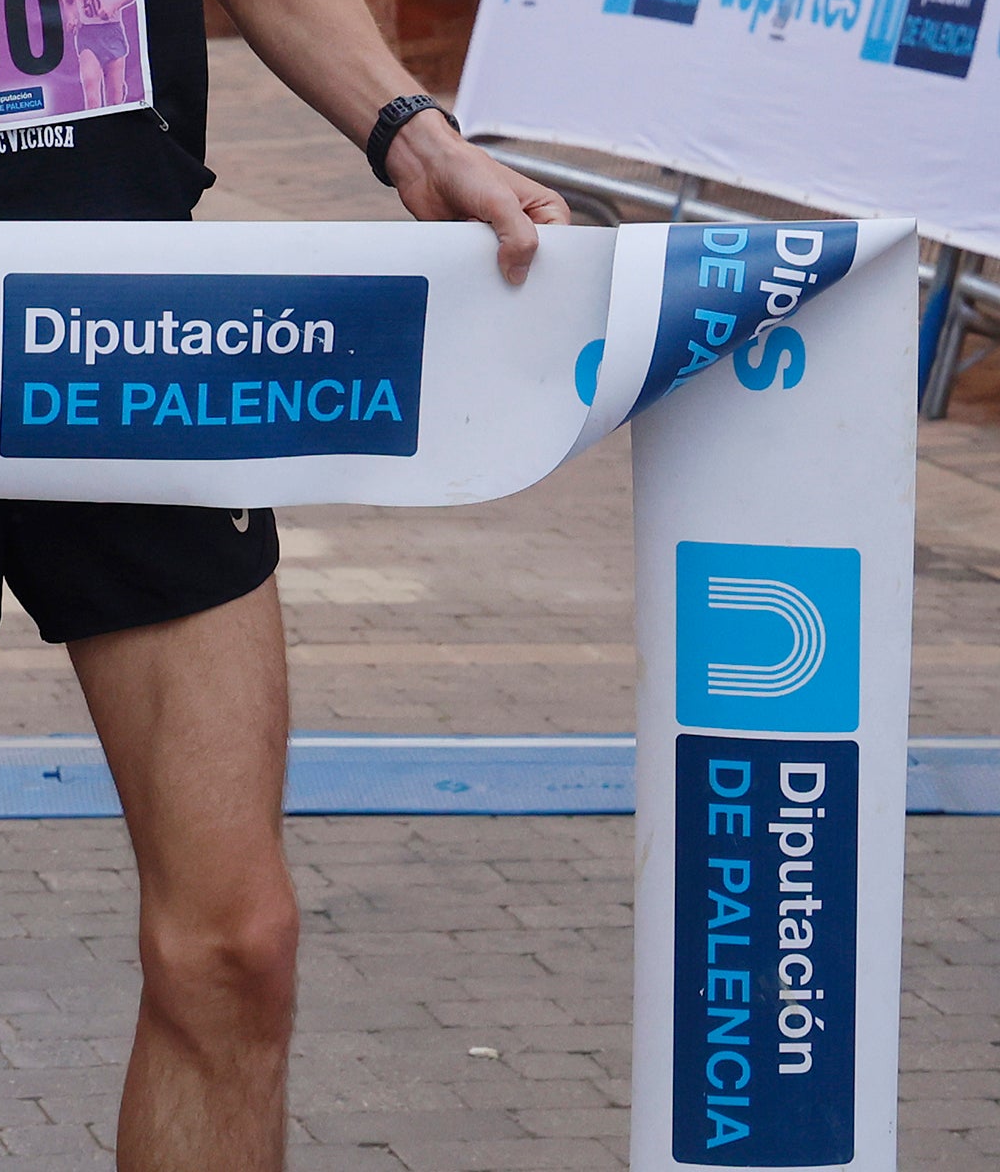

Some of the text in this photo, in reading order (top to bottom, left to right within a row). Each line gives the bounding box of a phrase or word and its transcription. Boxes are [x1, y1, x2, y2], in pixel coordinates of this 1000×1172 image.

[5, 99, 43, 111] PALENCIA
[6, 126, 75, 153] VICIOSA
[699, 228, 749, 293] DE
[23, 307, 335, 365] Diputación
[22, 378, 404, 426] DE PALENCIA
[768, 762, 826, 1075] Diputación
[706, 759, 752, 1150] DE PALENCIA
